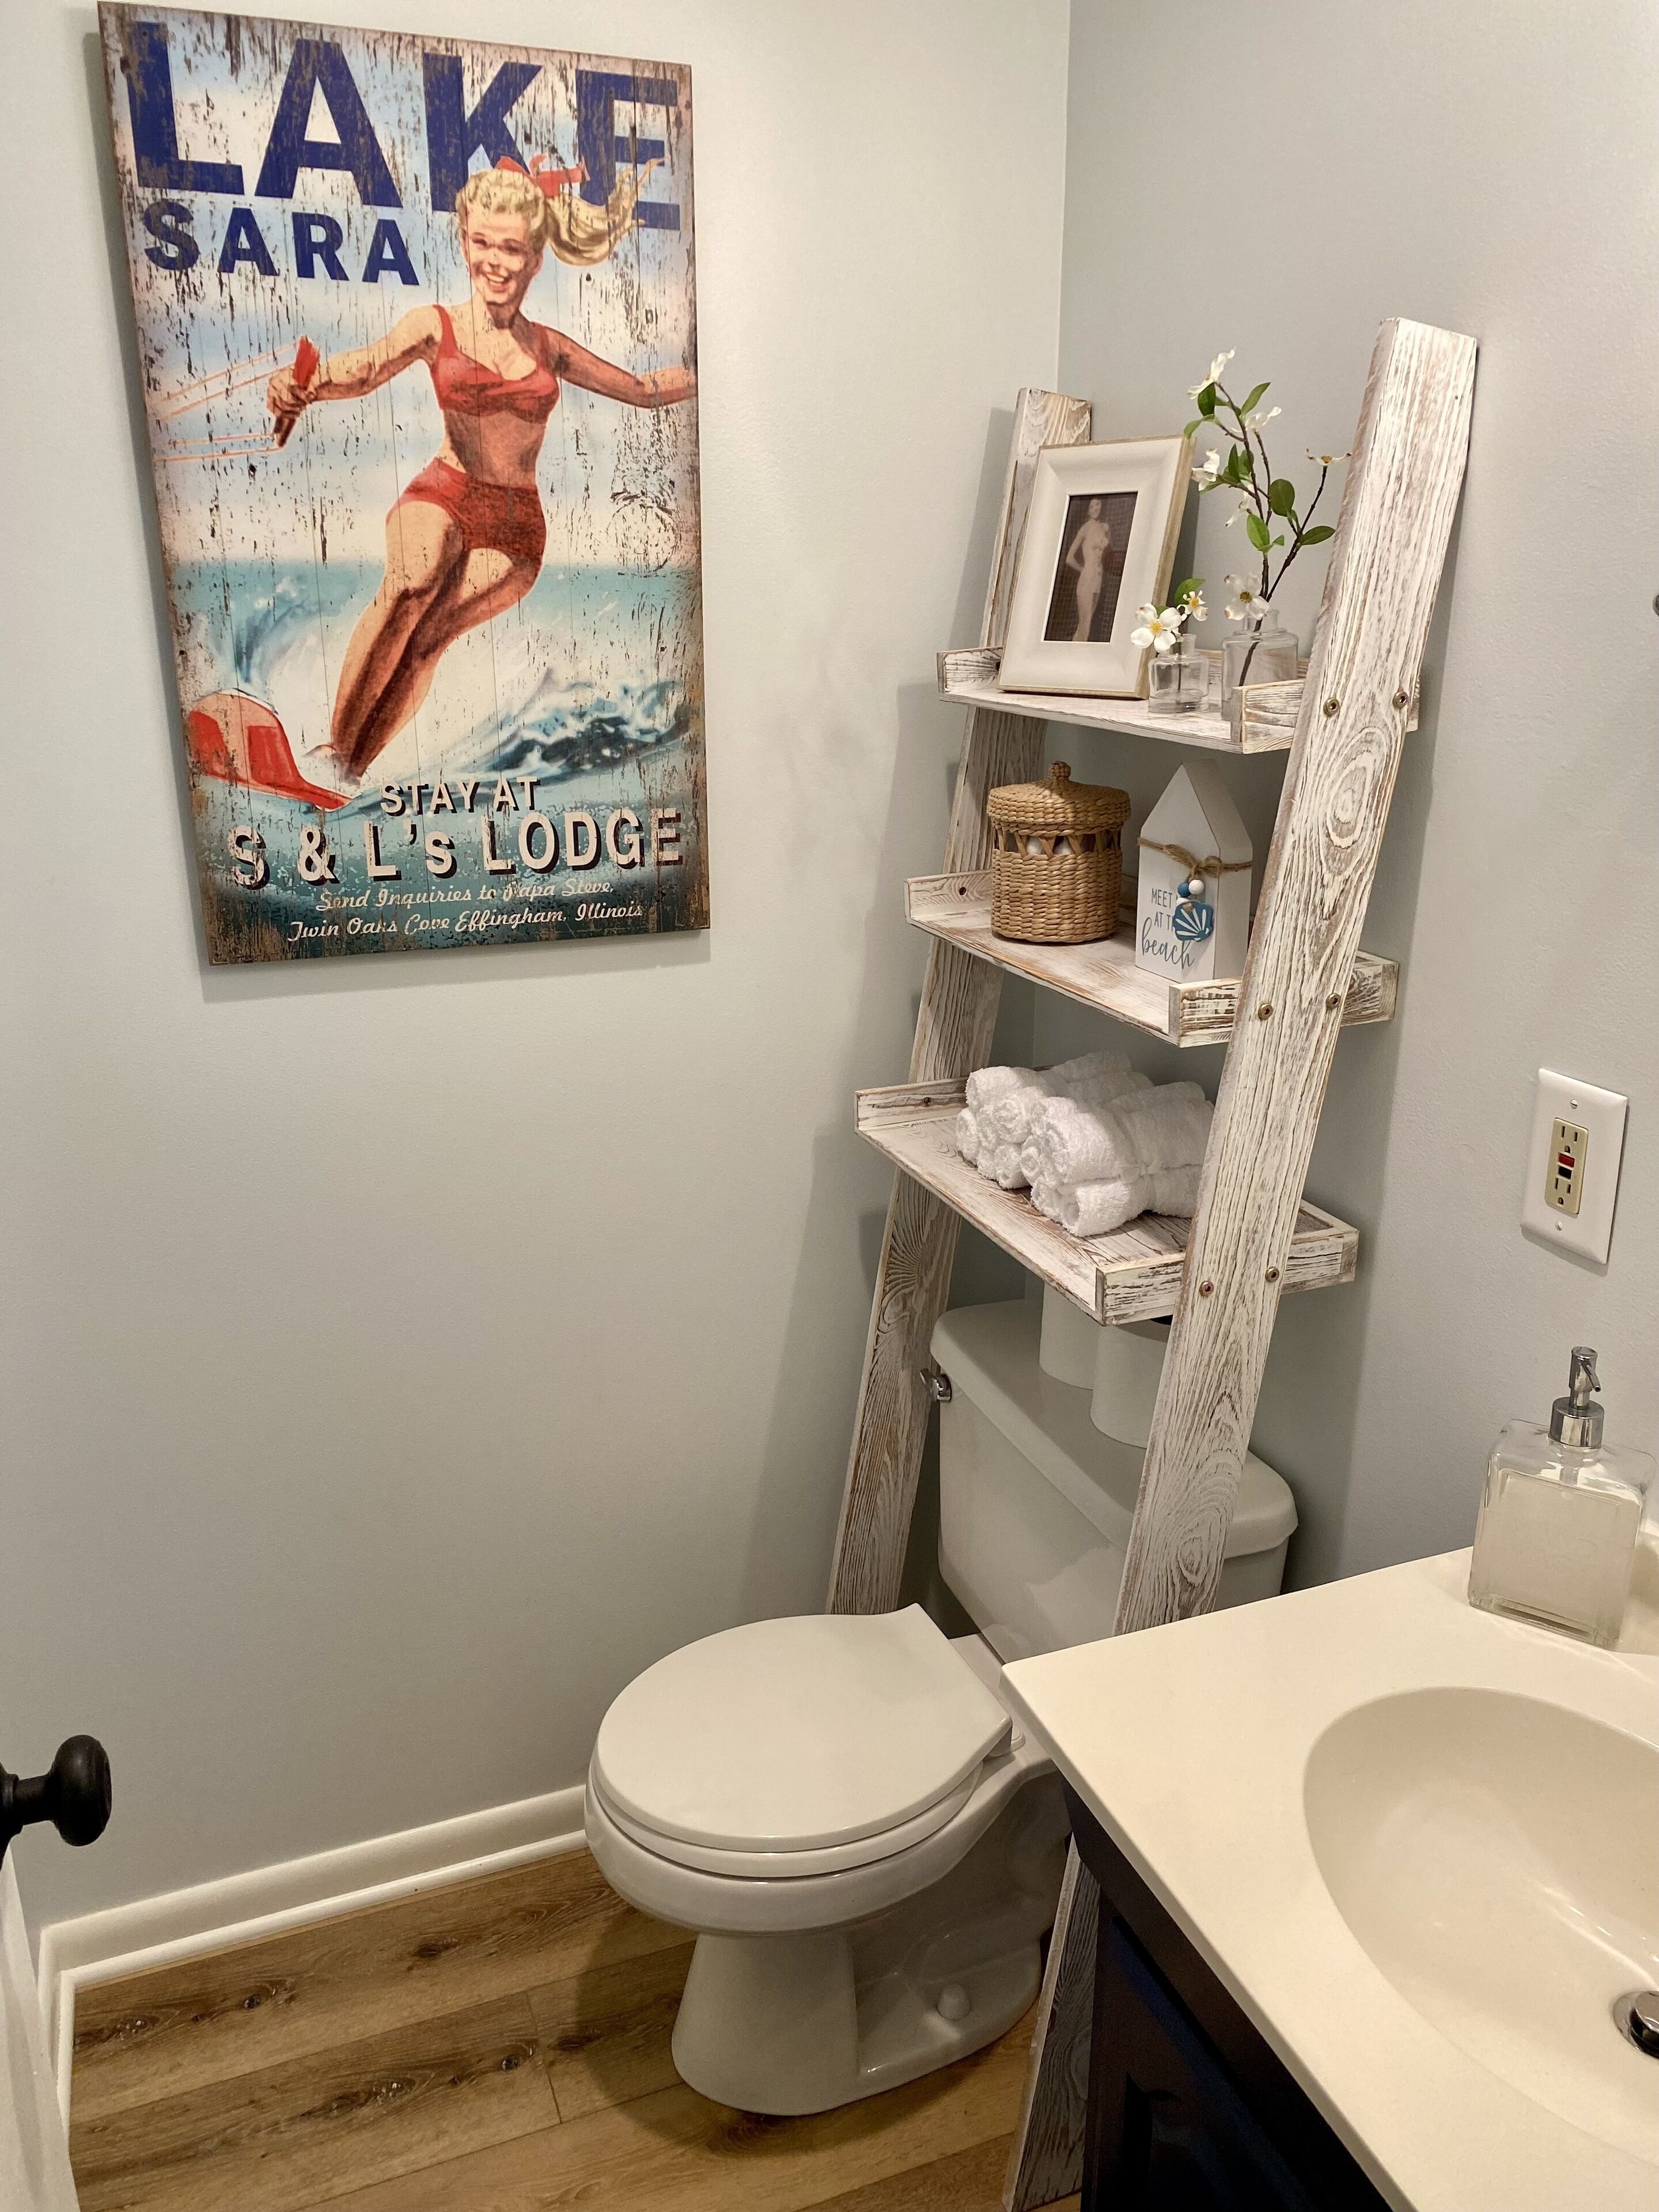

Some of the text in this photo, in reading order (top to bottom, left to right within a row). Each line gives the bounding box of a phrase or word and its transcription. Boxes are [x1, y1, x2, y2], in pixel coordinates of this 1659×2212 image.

[125, 21, 681, 232] LAKE
[143, 198, 419, 286] SARA
[380, 775, 540, 817] STAY AT
[229, 824, 271, 891] S
[298, 824, 340, 887] &
[480, 806, 683, 876] LODGE
[316, 889, 370, 911] Send
[375, 884, 471, 909] Inquiries
[478, 884, 497, 900] to
[1152, 887, 1173, 909] MEET
[288, 920, 339, 942] Twin
[347, 917, 397, 935] Oaks
[404, 914, 449, 935] Cove
[575, 901, 643, 922] Illinois
[1154, 911, 1163, 929] AT
[1142, 916, 1195, 969] beach
